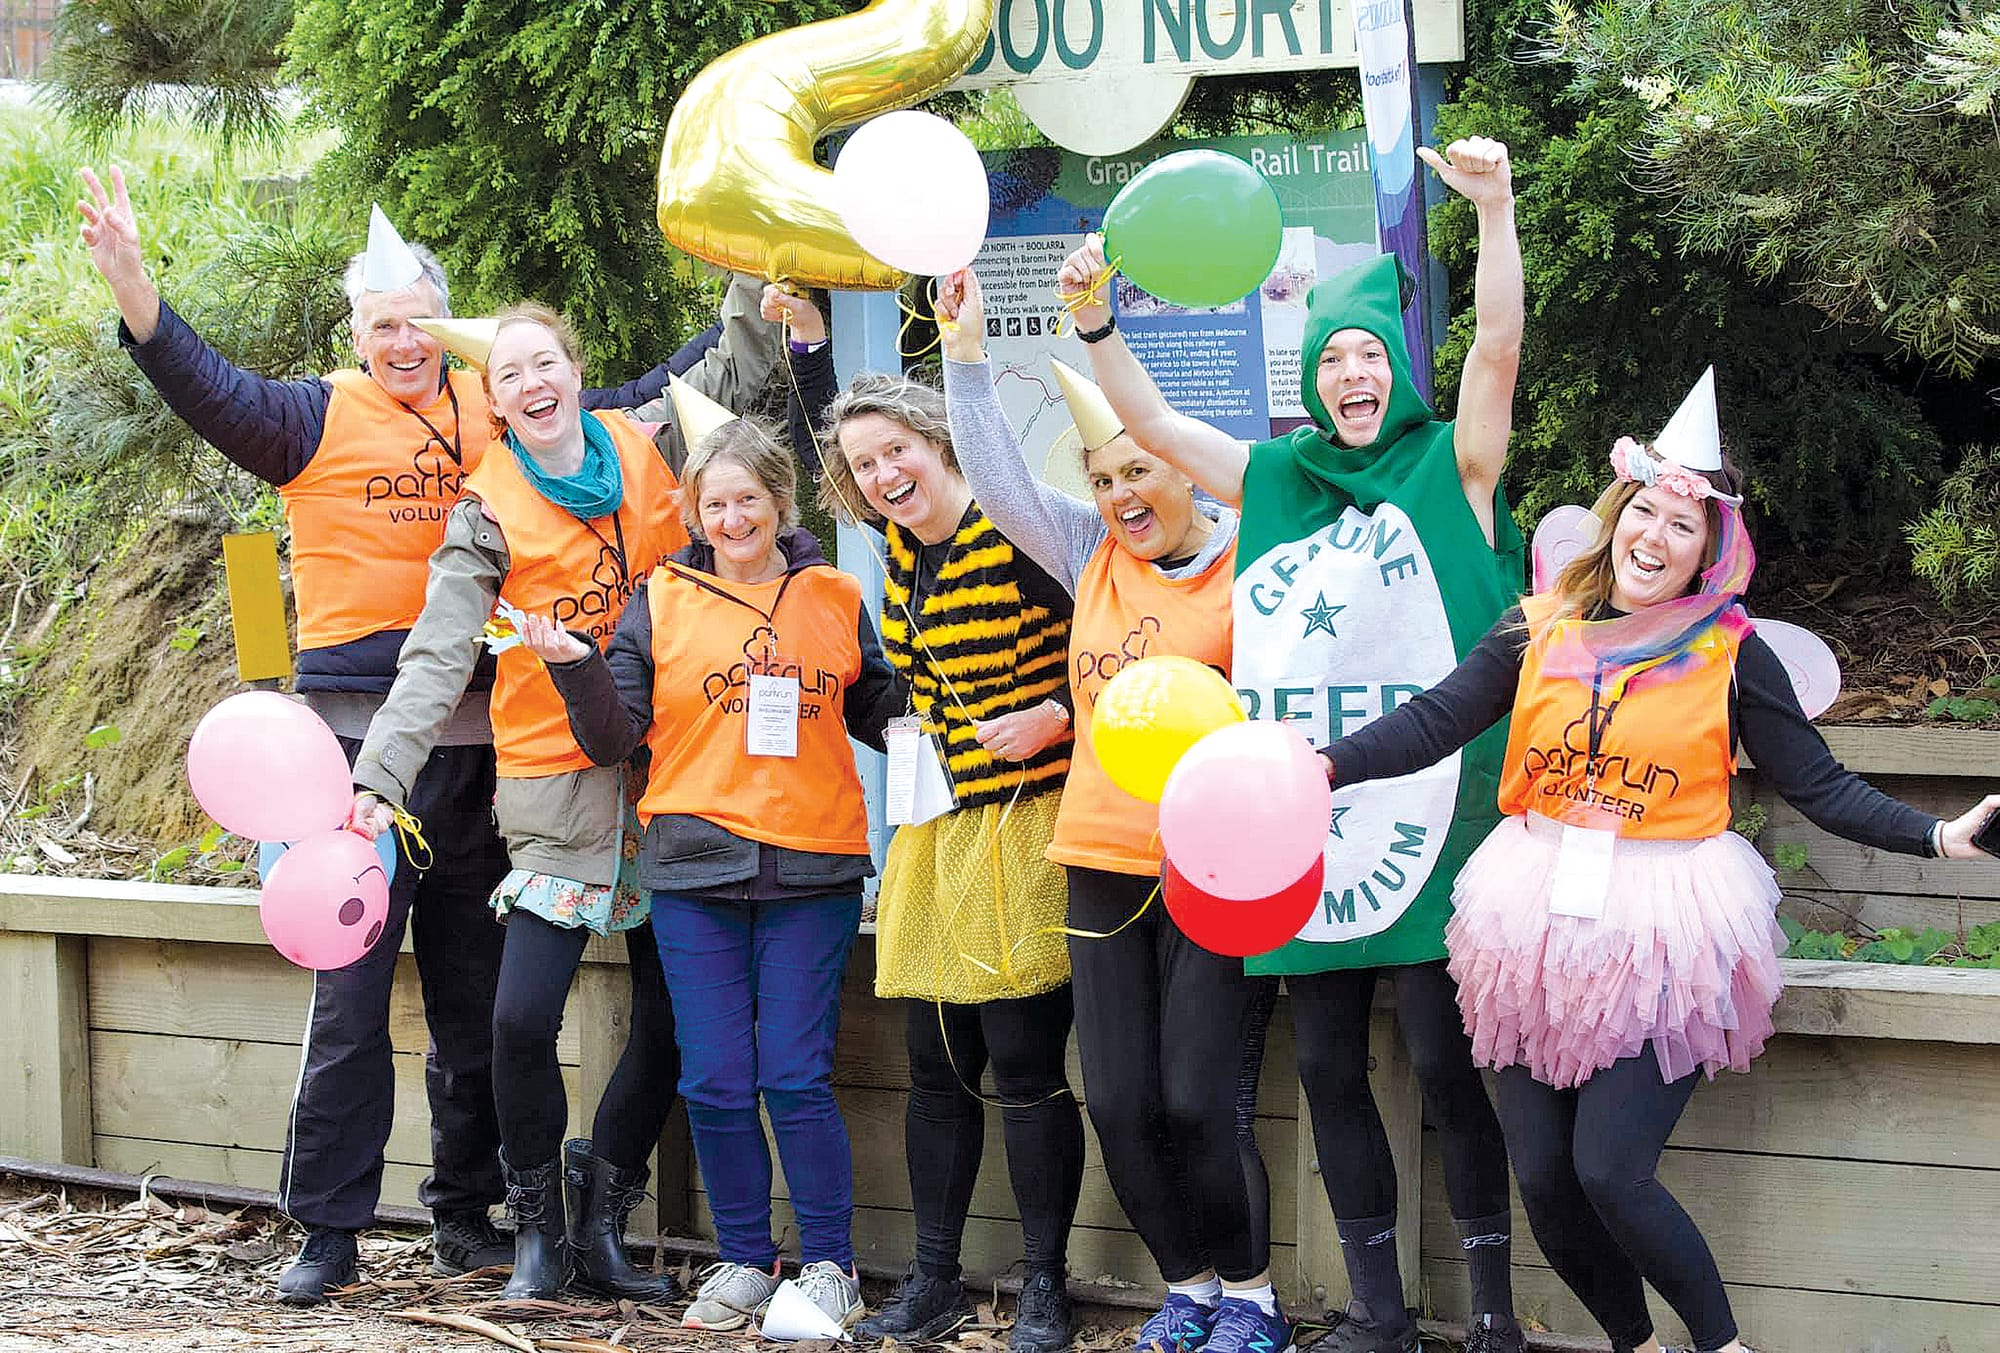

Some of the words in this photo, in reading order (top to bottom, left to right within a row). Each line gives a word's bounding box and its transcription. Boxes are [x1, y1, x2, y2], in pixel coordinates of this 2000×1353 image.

[1250, 145, 1299, 176] Rail
[1306, 141, 1369, 173] Trail
[991, 243, 1016, 252] NORTH
[1026, 241, 1065, 250] BOOLARRA
[975, 257, 1010, 266] mmencing
[976, 269, 1014, 278] roximately
[1016, 267, 1030, 276] 600
[1032, 267, 1057, 275] metres
[1019, 279, 1036, 288] from
[990, 294, 1005, 303] easy
[1008, 293, 1027, 303] grade
[1001, 305, 1020, 314] hours
[1022, 304, 1038, 313] walk
[1324, 821, 1428, 925] MIUM
